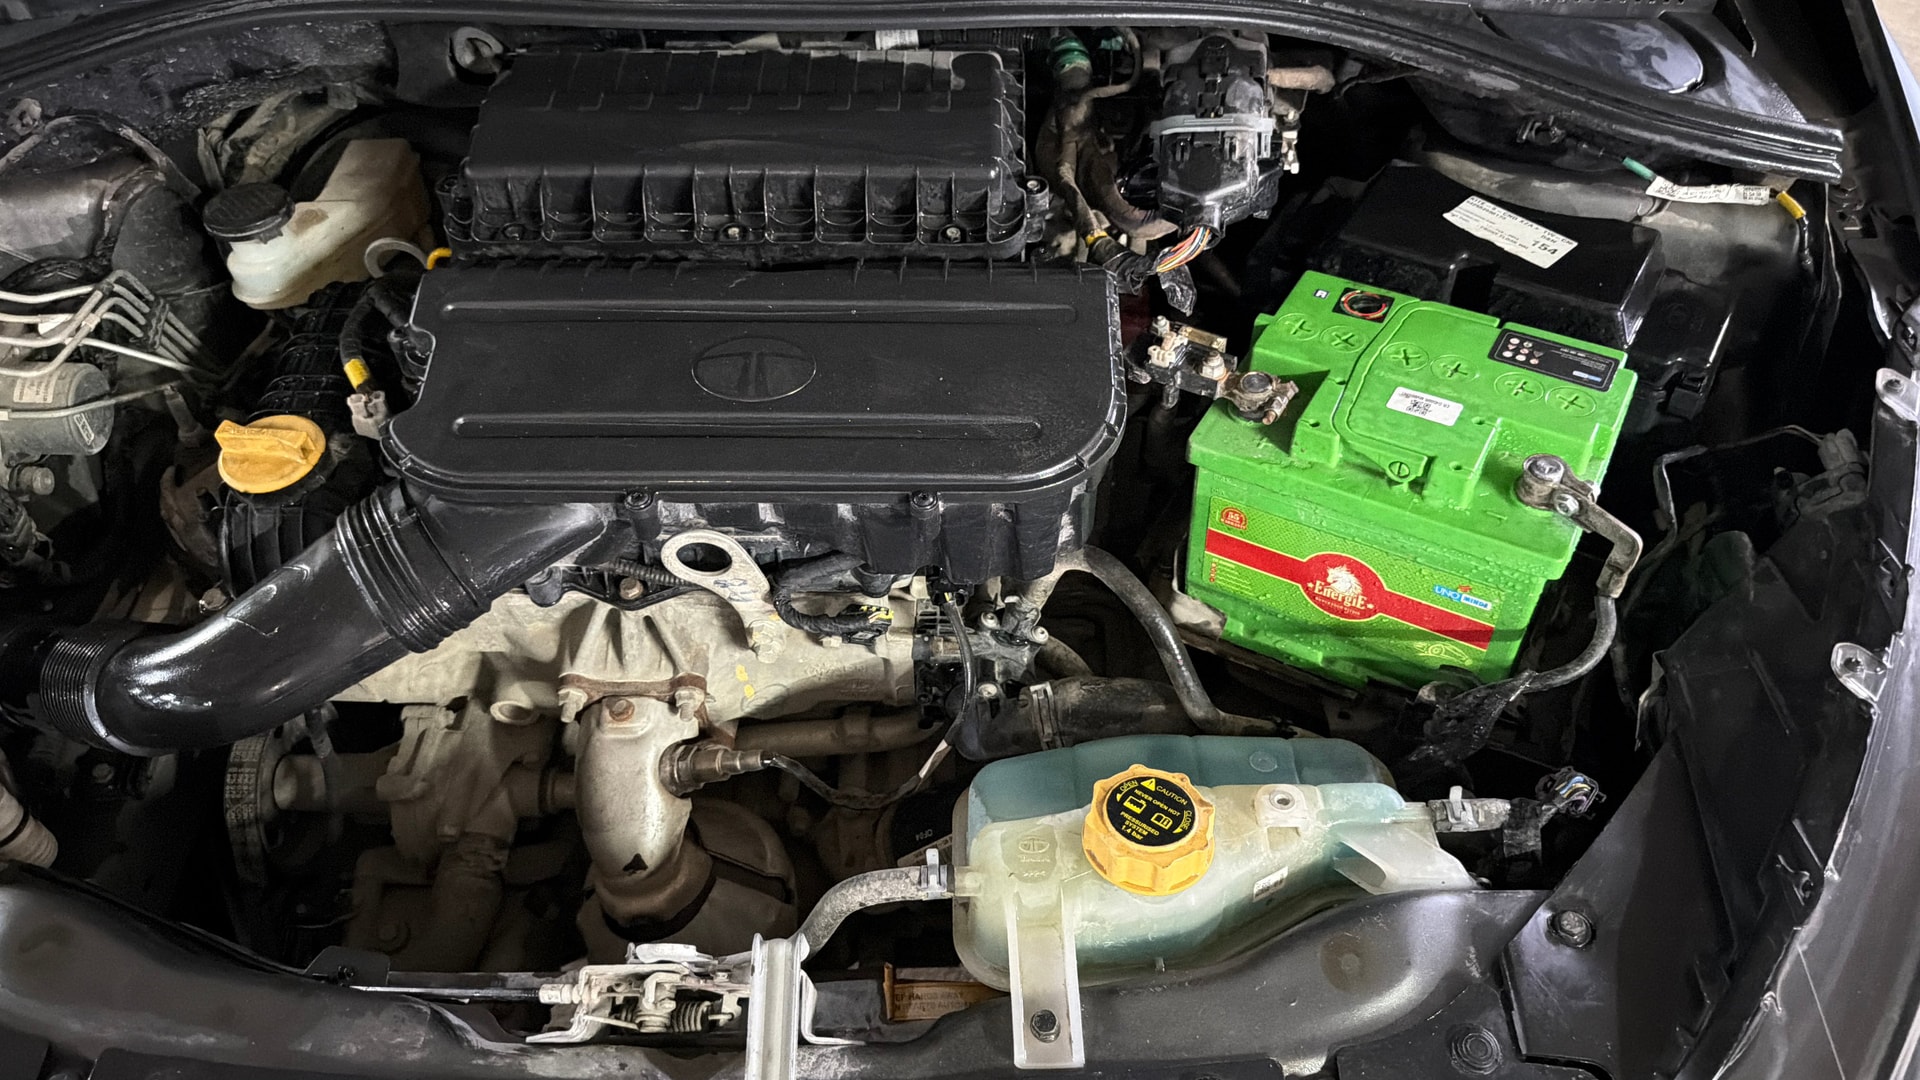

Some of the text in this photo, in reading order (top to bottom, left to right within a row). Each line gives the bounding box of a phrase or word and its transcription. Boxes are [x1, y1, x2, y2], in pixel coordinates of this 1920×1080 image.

[1530, 239, 1559, 255] 154
[1434, 585, 1461, 601] UNO
[1119, 780, 1139, 791] OPEN
[1134, 789, 1181, 817] NEVER OPEN HOT
[1156, 785, 1188, 806] CAUTION
[1120, 811, 1160, 836] PRESSURISED
[1124, 820, 1149, 836] SYSTEM
[1131, 830, 1144, 840] bar
